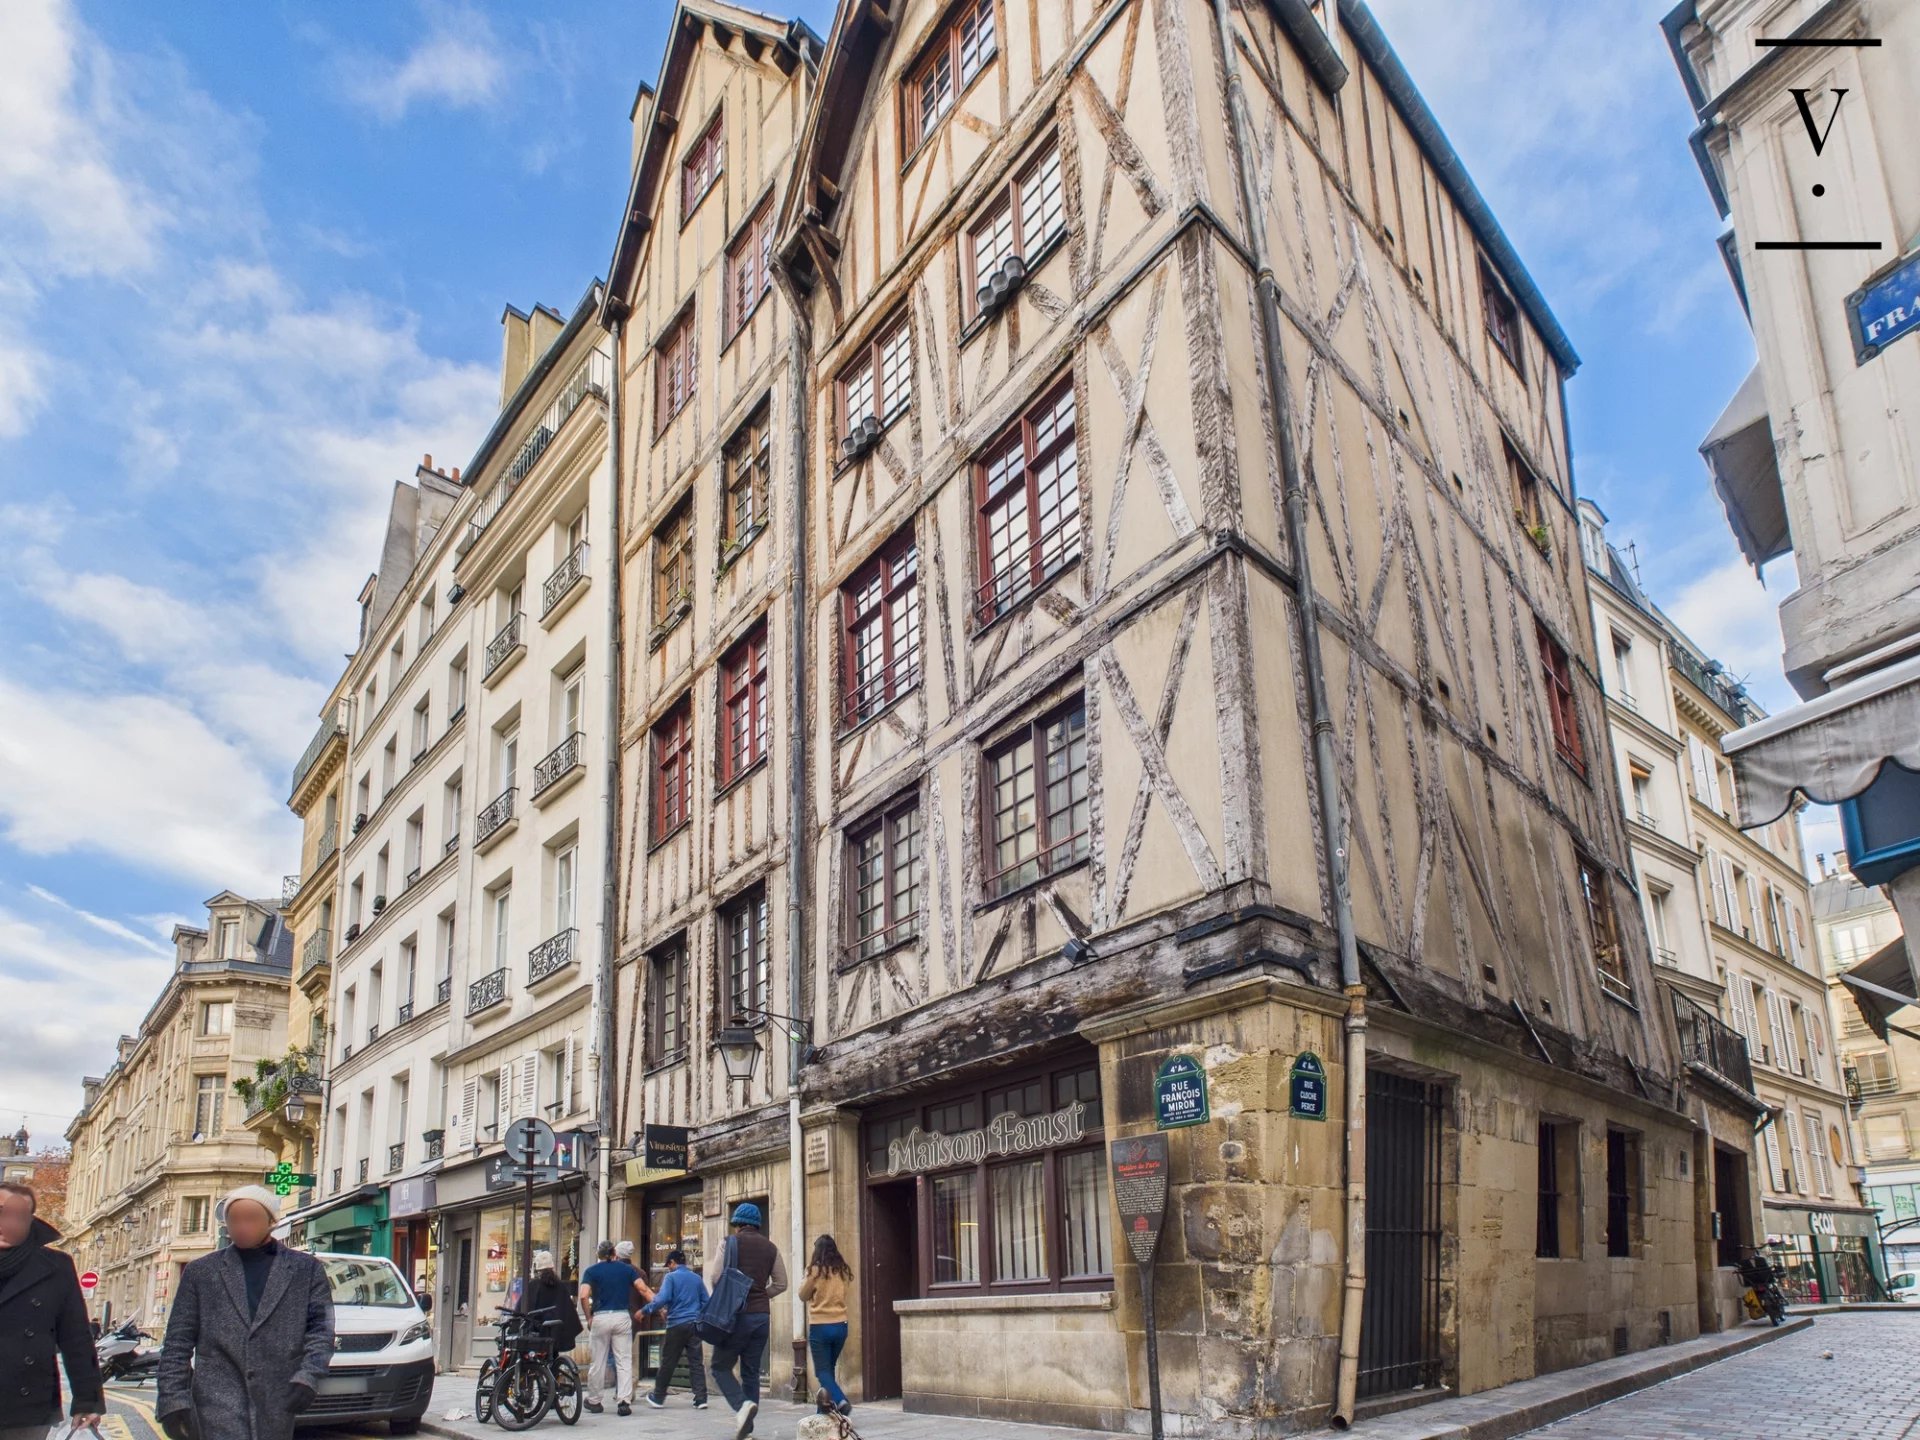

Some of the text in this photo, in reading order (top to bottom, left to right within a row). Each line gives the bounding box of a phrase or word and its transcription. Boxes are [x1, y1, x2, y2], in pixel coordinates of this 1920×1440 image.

[1171, 1080, 1189, 1092] RUE
[1304, 1080, 1314, 1090] RUE
[1161, 1088, 1201, 1104] FRANÇOIS
[1300, 1090, 1317, 1101] CLOCHE
[1168, 1099, 1195, 1112] MIRON
[888, 1126, 985, 1177] Maison
[991, 1101, 1085, 1155] Faust
[269, 1174, 299, 1184] 17/12
